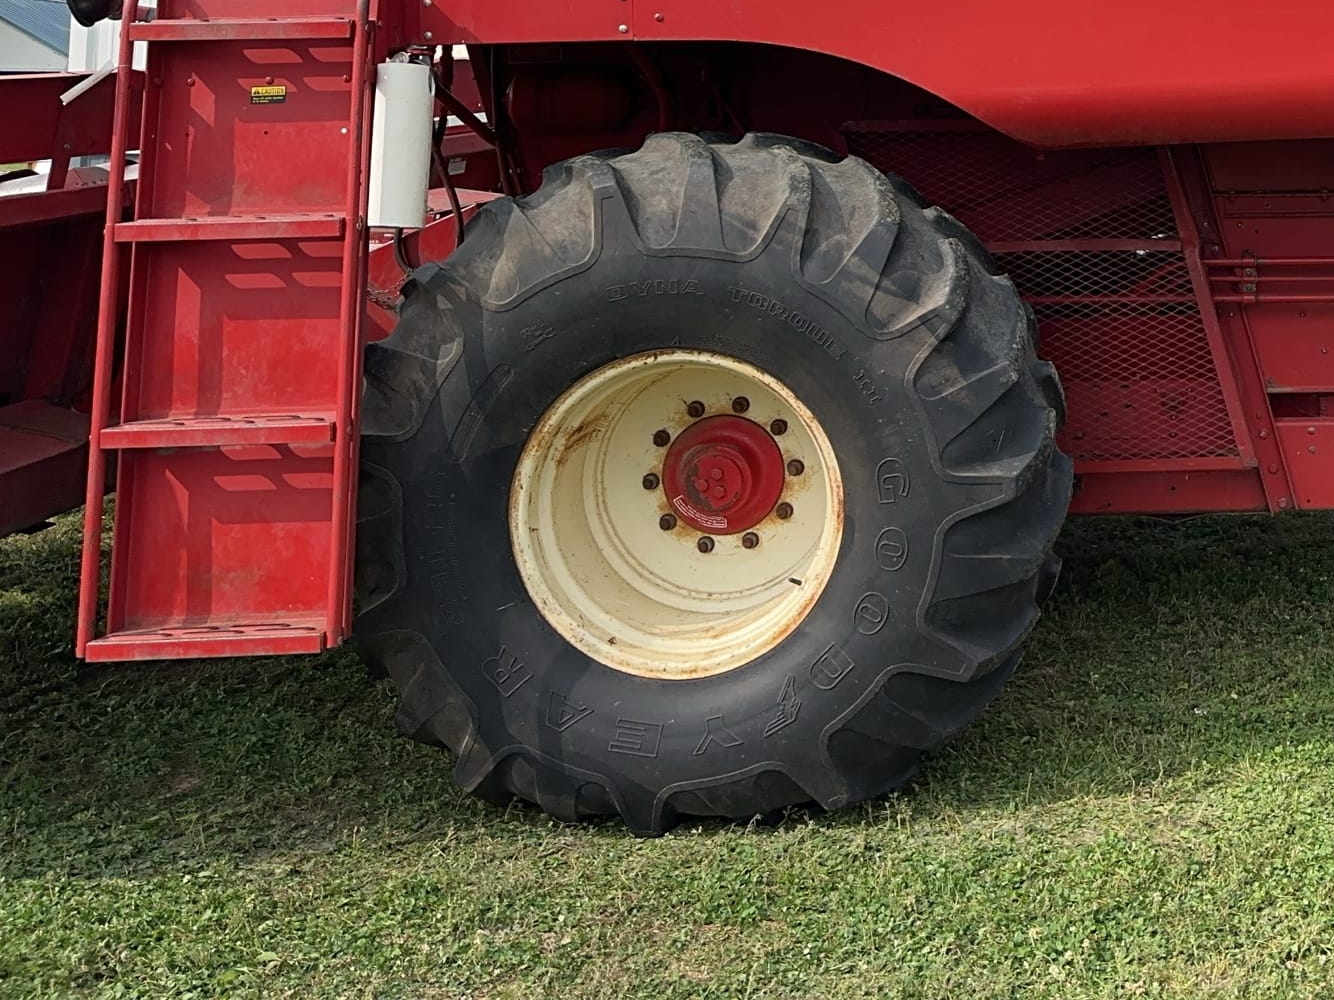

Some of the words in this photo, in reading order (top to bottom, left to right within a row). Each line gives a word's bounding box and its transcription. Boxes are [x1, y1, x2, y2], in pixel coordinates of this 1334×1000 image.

[606, 279, 705, 301] DYNA
[729, 286, 847, 361] TORQUE
[481, 456, 912, 758] GOODYEAR
